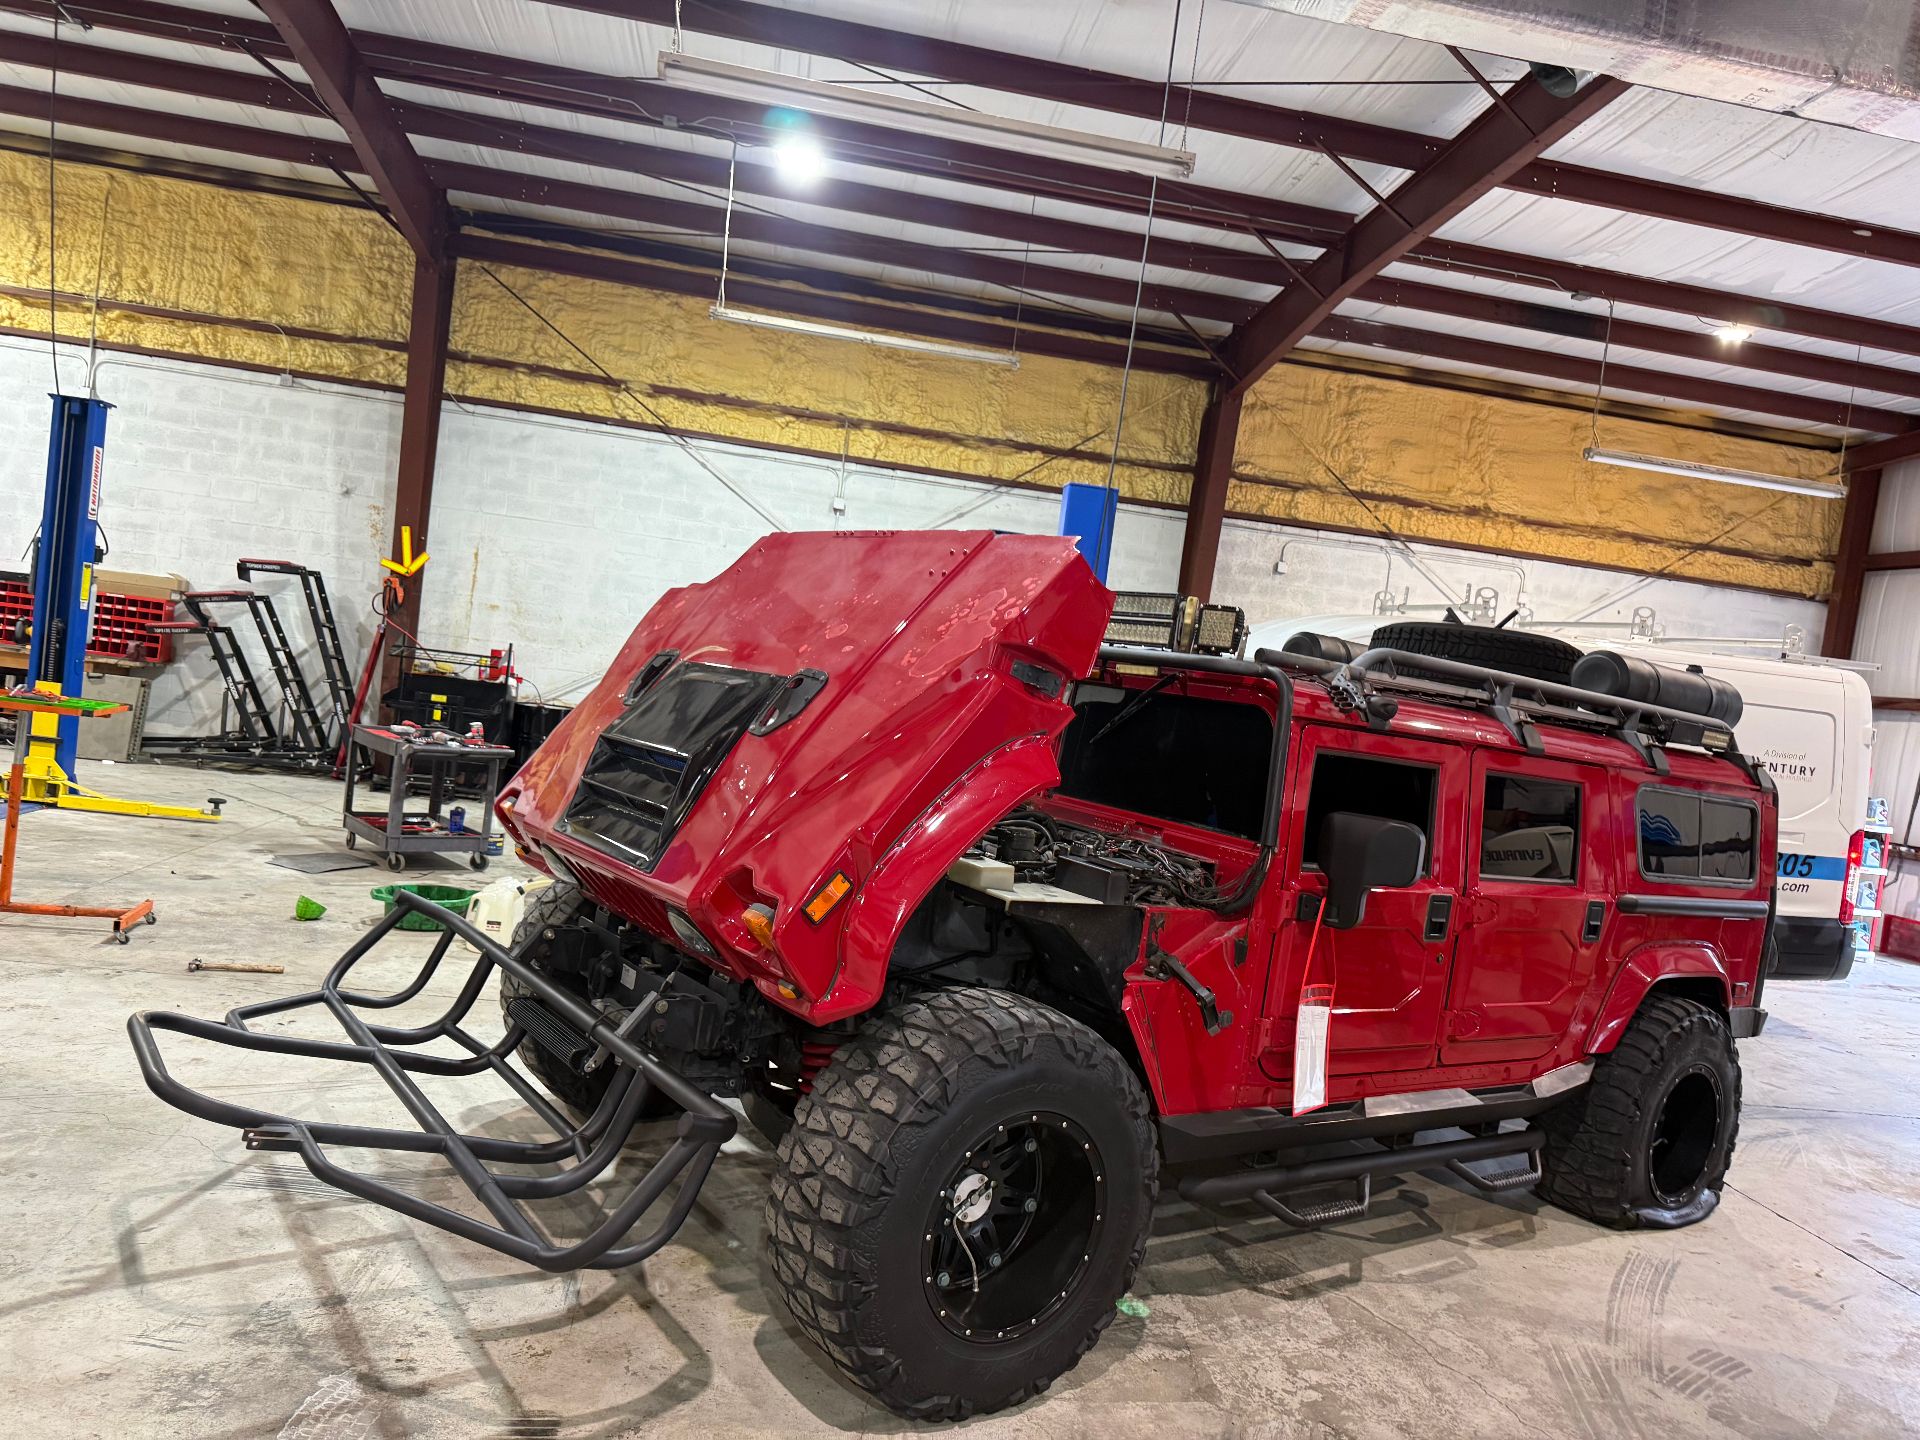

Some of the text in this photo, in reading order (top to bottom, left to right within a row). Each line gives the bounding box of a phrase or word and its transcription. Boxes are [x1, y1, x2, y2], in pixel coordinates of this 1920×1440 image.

[90, 448, 101, 507] NATIONWIDE
[1763, 749, 1807, 761] A Division of
